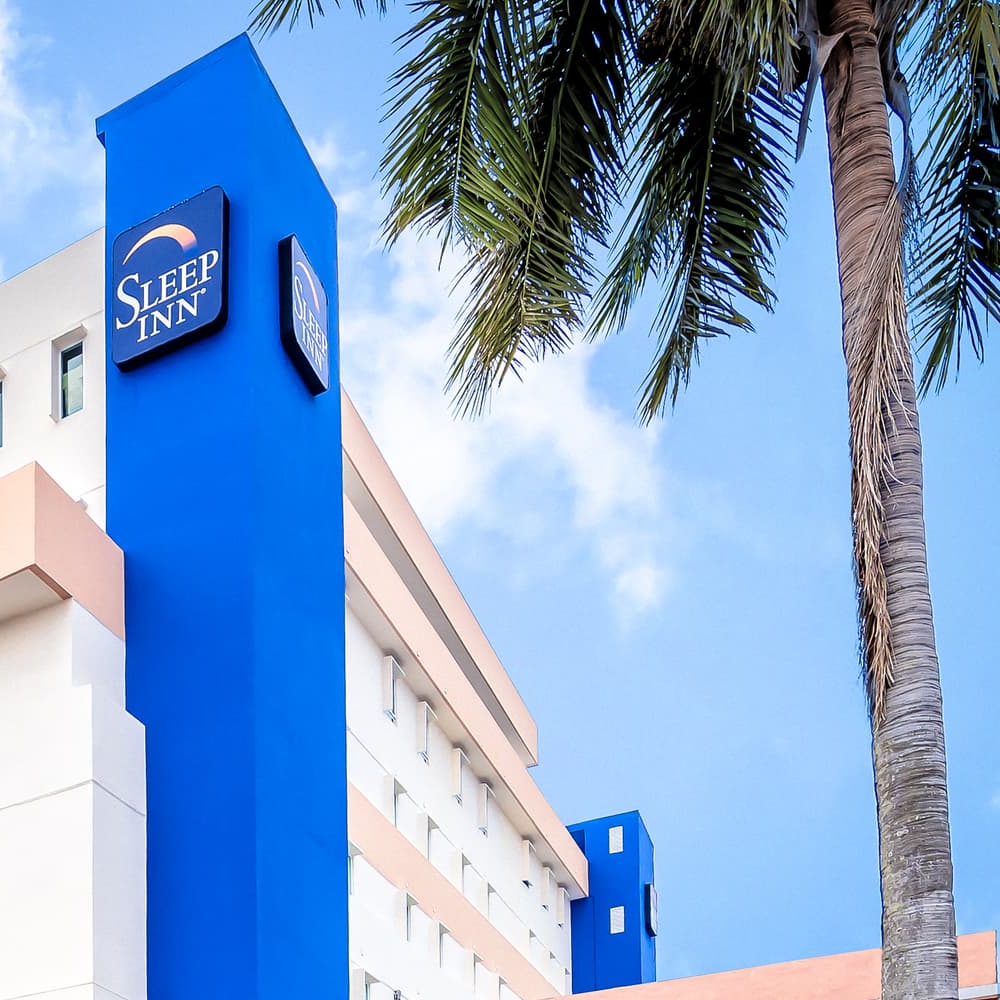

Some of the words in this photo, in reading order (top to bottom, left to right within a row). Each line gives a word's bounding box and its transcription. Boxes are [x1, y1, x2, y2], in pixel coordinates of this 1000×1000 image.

[116, 249, 219, 330] SLEEP
[136, 290, 201, 343] INN
[294, 275, 328, 358] SLEEP
[302, 322, 323, 371] INN
